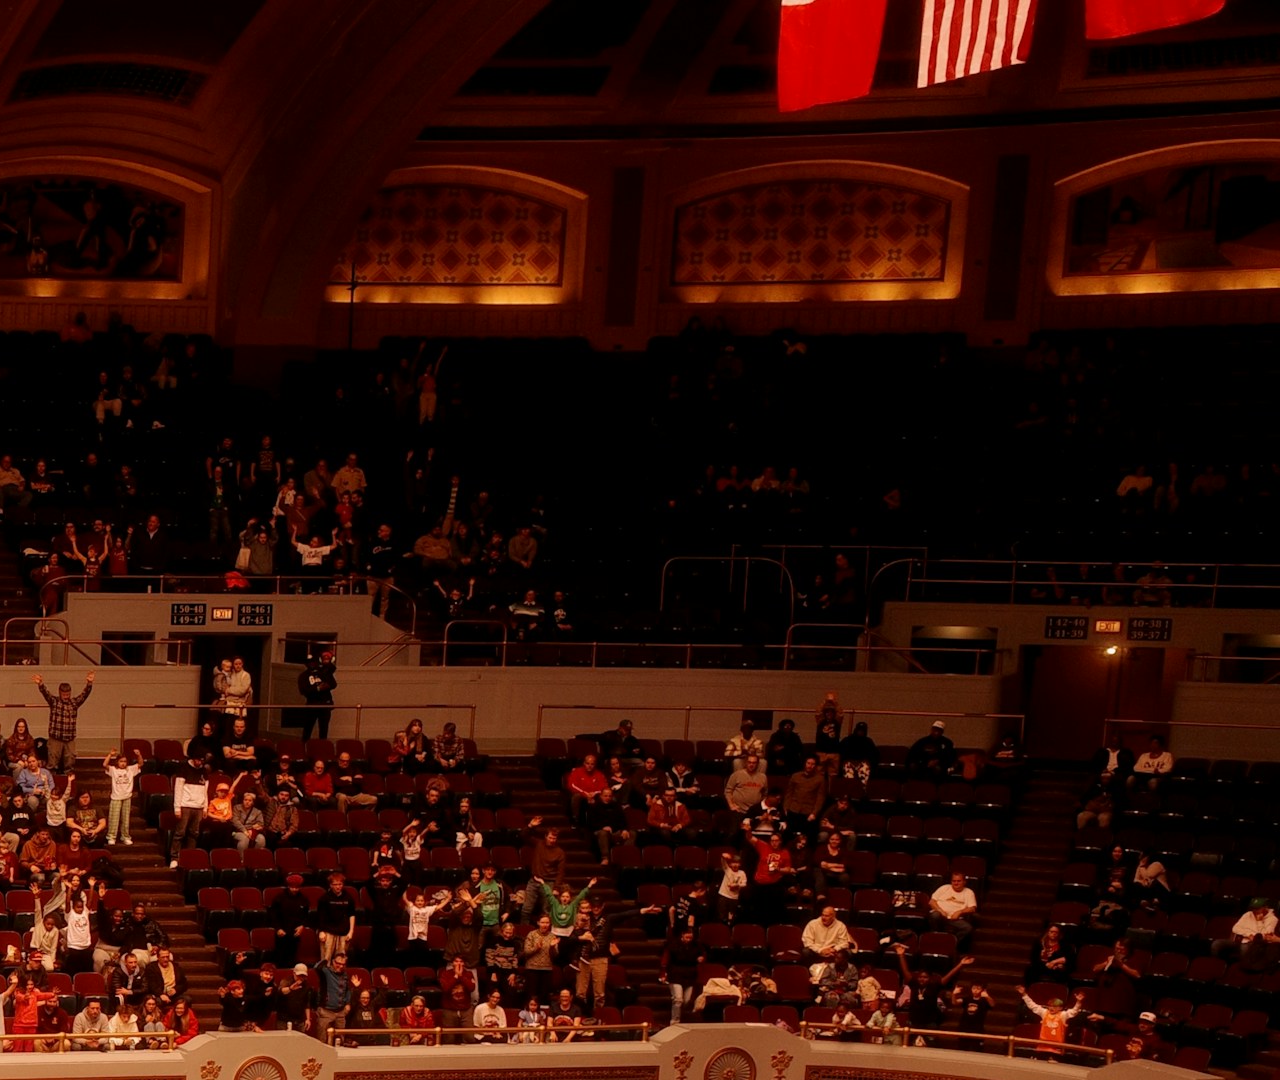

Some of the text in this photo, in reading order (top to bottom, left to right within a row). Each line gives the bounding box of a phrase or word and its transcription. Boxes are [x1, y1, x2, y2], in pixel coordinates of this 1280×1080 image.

[179, 605, 204, 614] 50-48
[215, 609, 230, 618] EXIT
[240, 605, 266, 614] 48-46
[178, 616, 203, 625] 49-47
[240, 616, 265, 625] 47-45
[1099, 622, 1117, 631] EXIT
